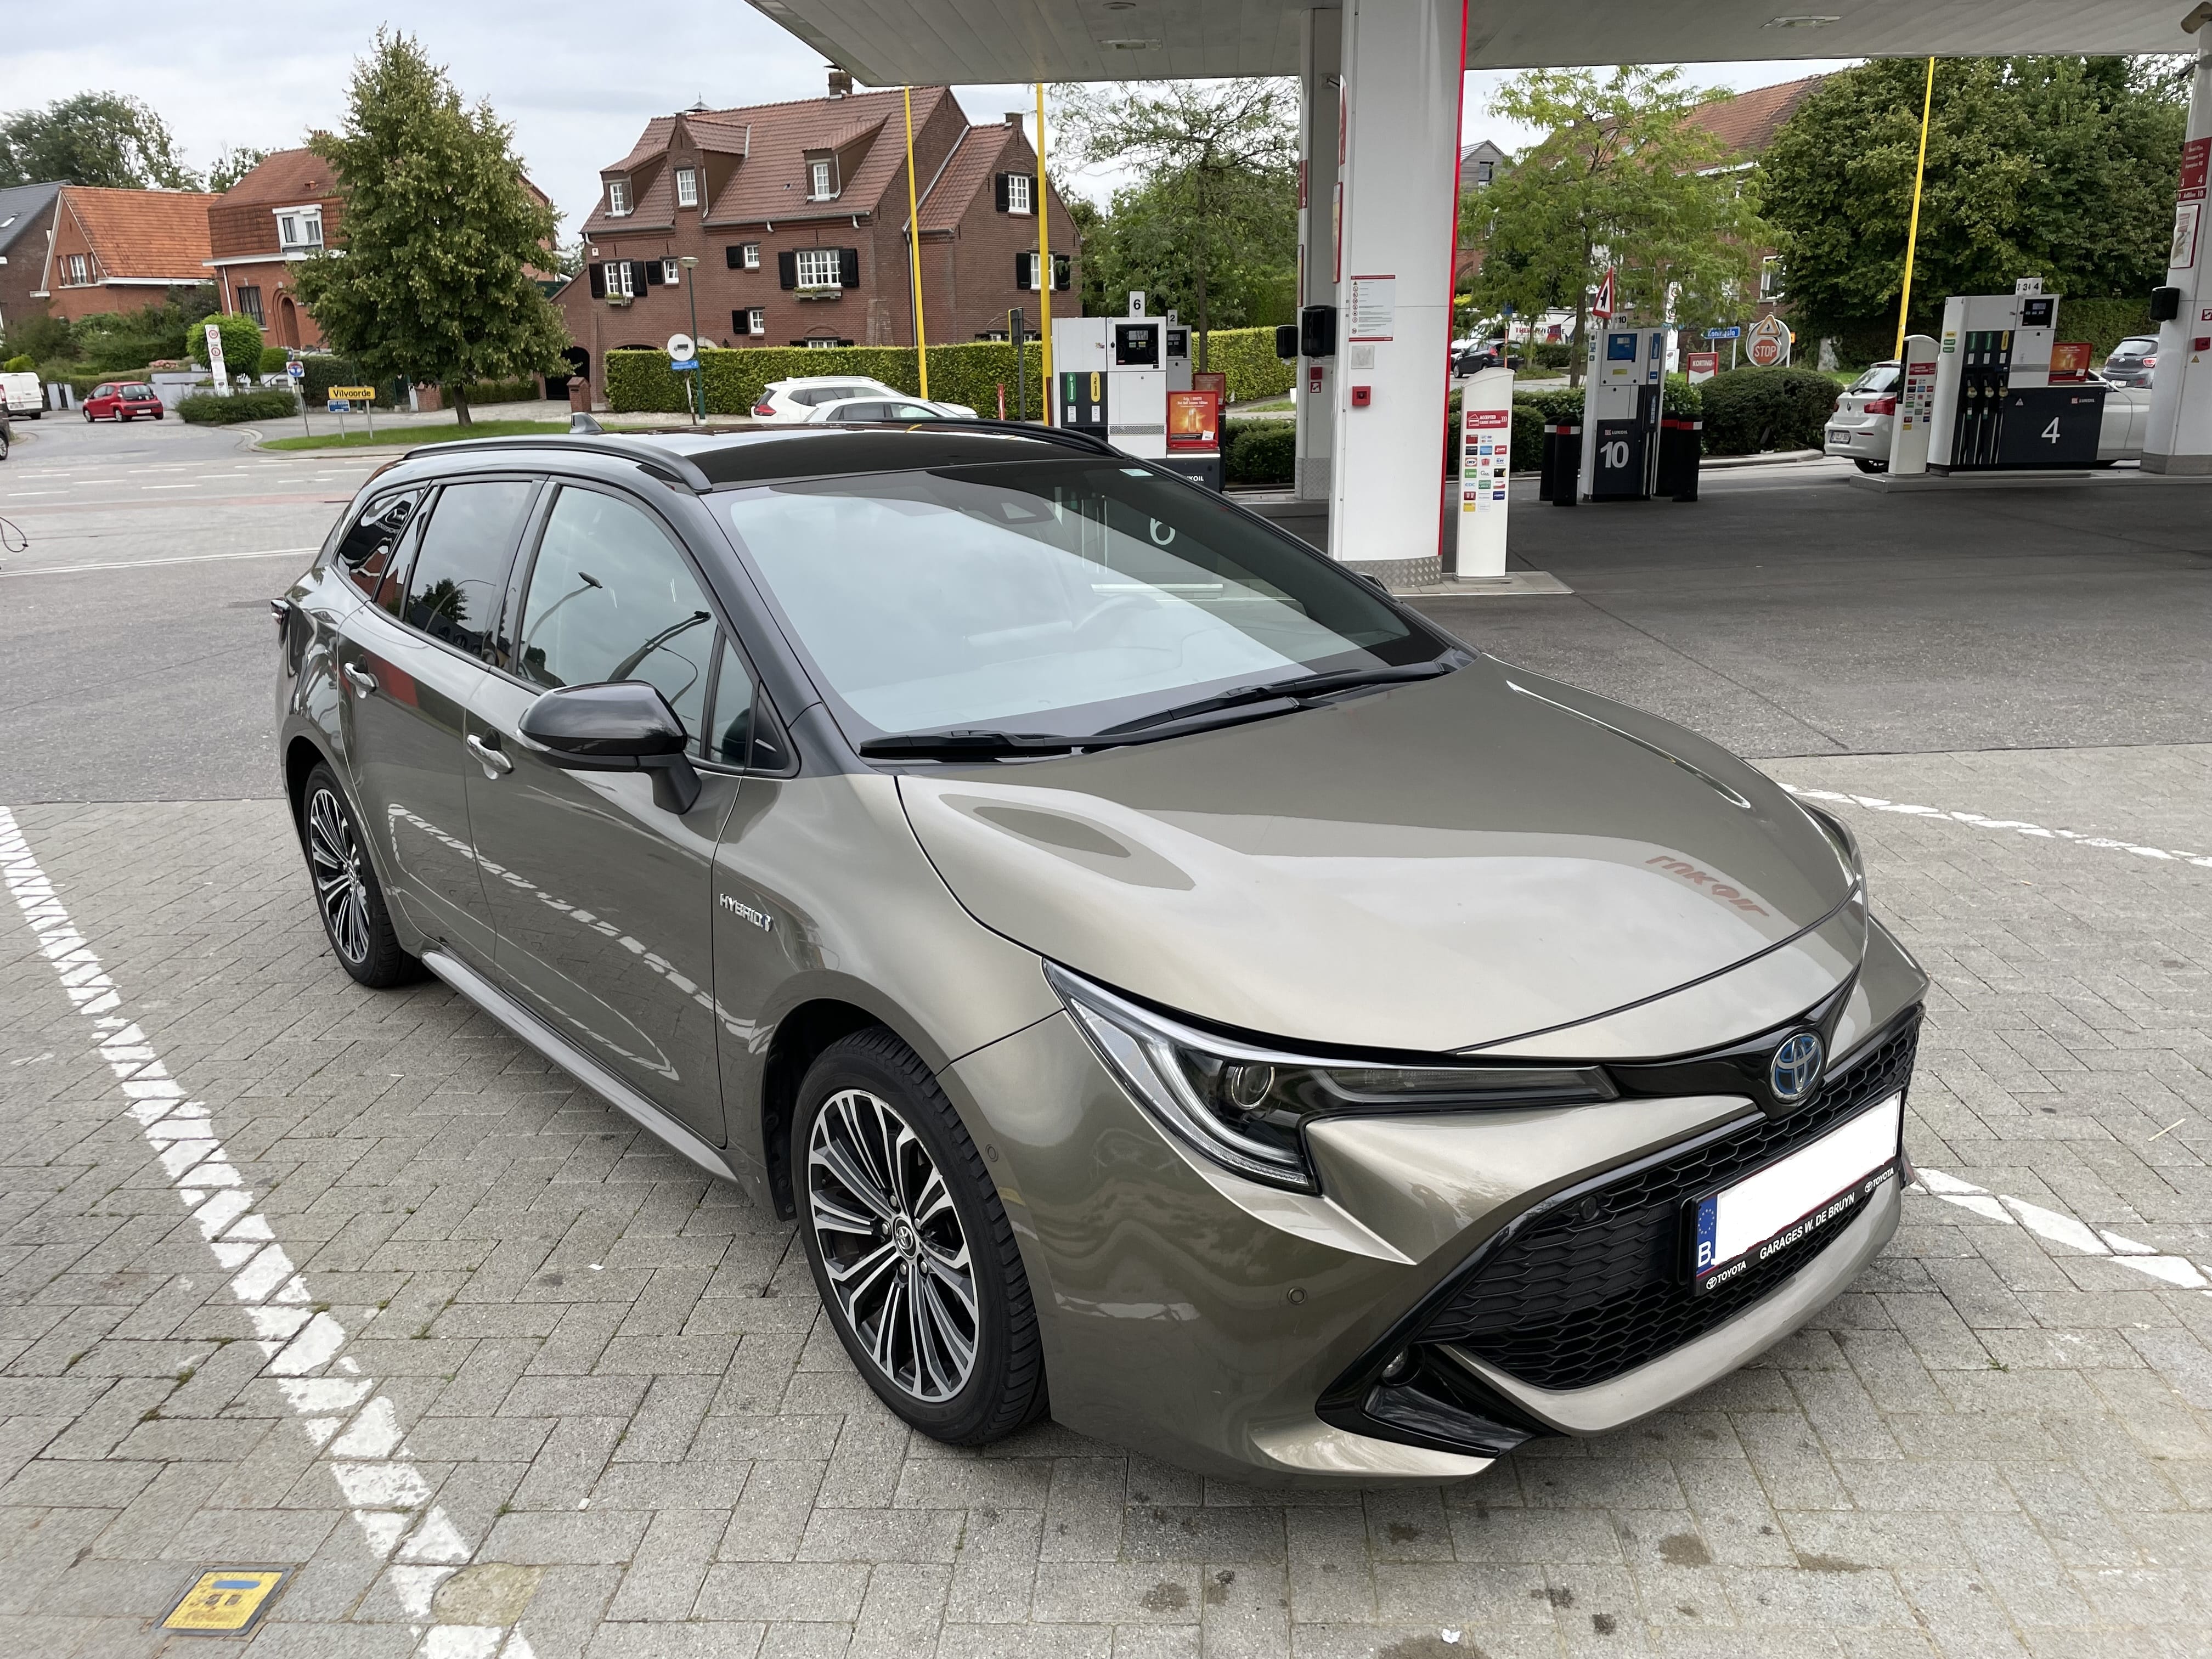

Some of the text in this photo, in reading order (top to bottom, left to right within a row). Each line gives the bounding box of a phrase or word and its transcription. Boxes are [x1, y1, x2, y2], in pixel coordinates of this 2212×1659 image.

[2198, 174, 2203, 184] 4
[1133, 299, 1141, 310] 6
[1754, 345, 1777, 357] STOP
[2041, 417, 2061, 444] 4
[1600, 441, 1629, 468] 10
[719, 893, 763, 928] HYBRID
[1872, 1167, 1894, 1187] TOYOTA
[1759, 1192, 1855, 1260] GARAGES W. DE BRUYN
[1697, 1240, 1712, 1268] B
[1717, 1260, 1747, 1284] TOYOTA
